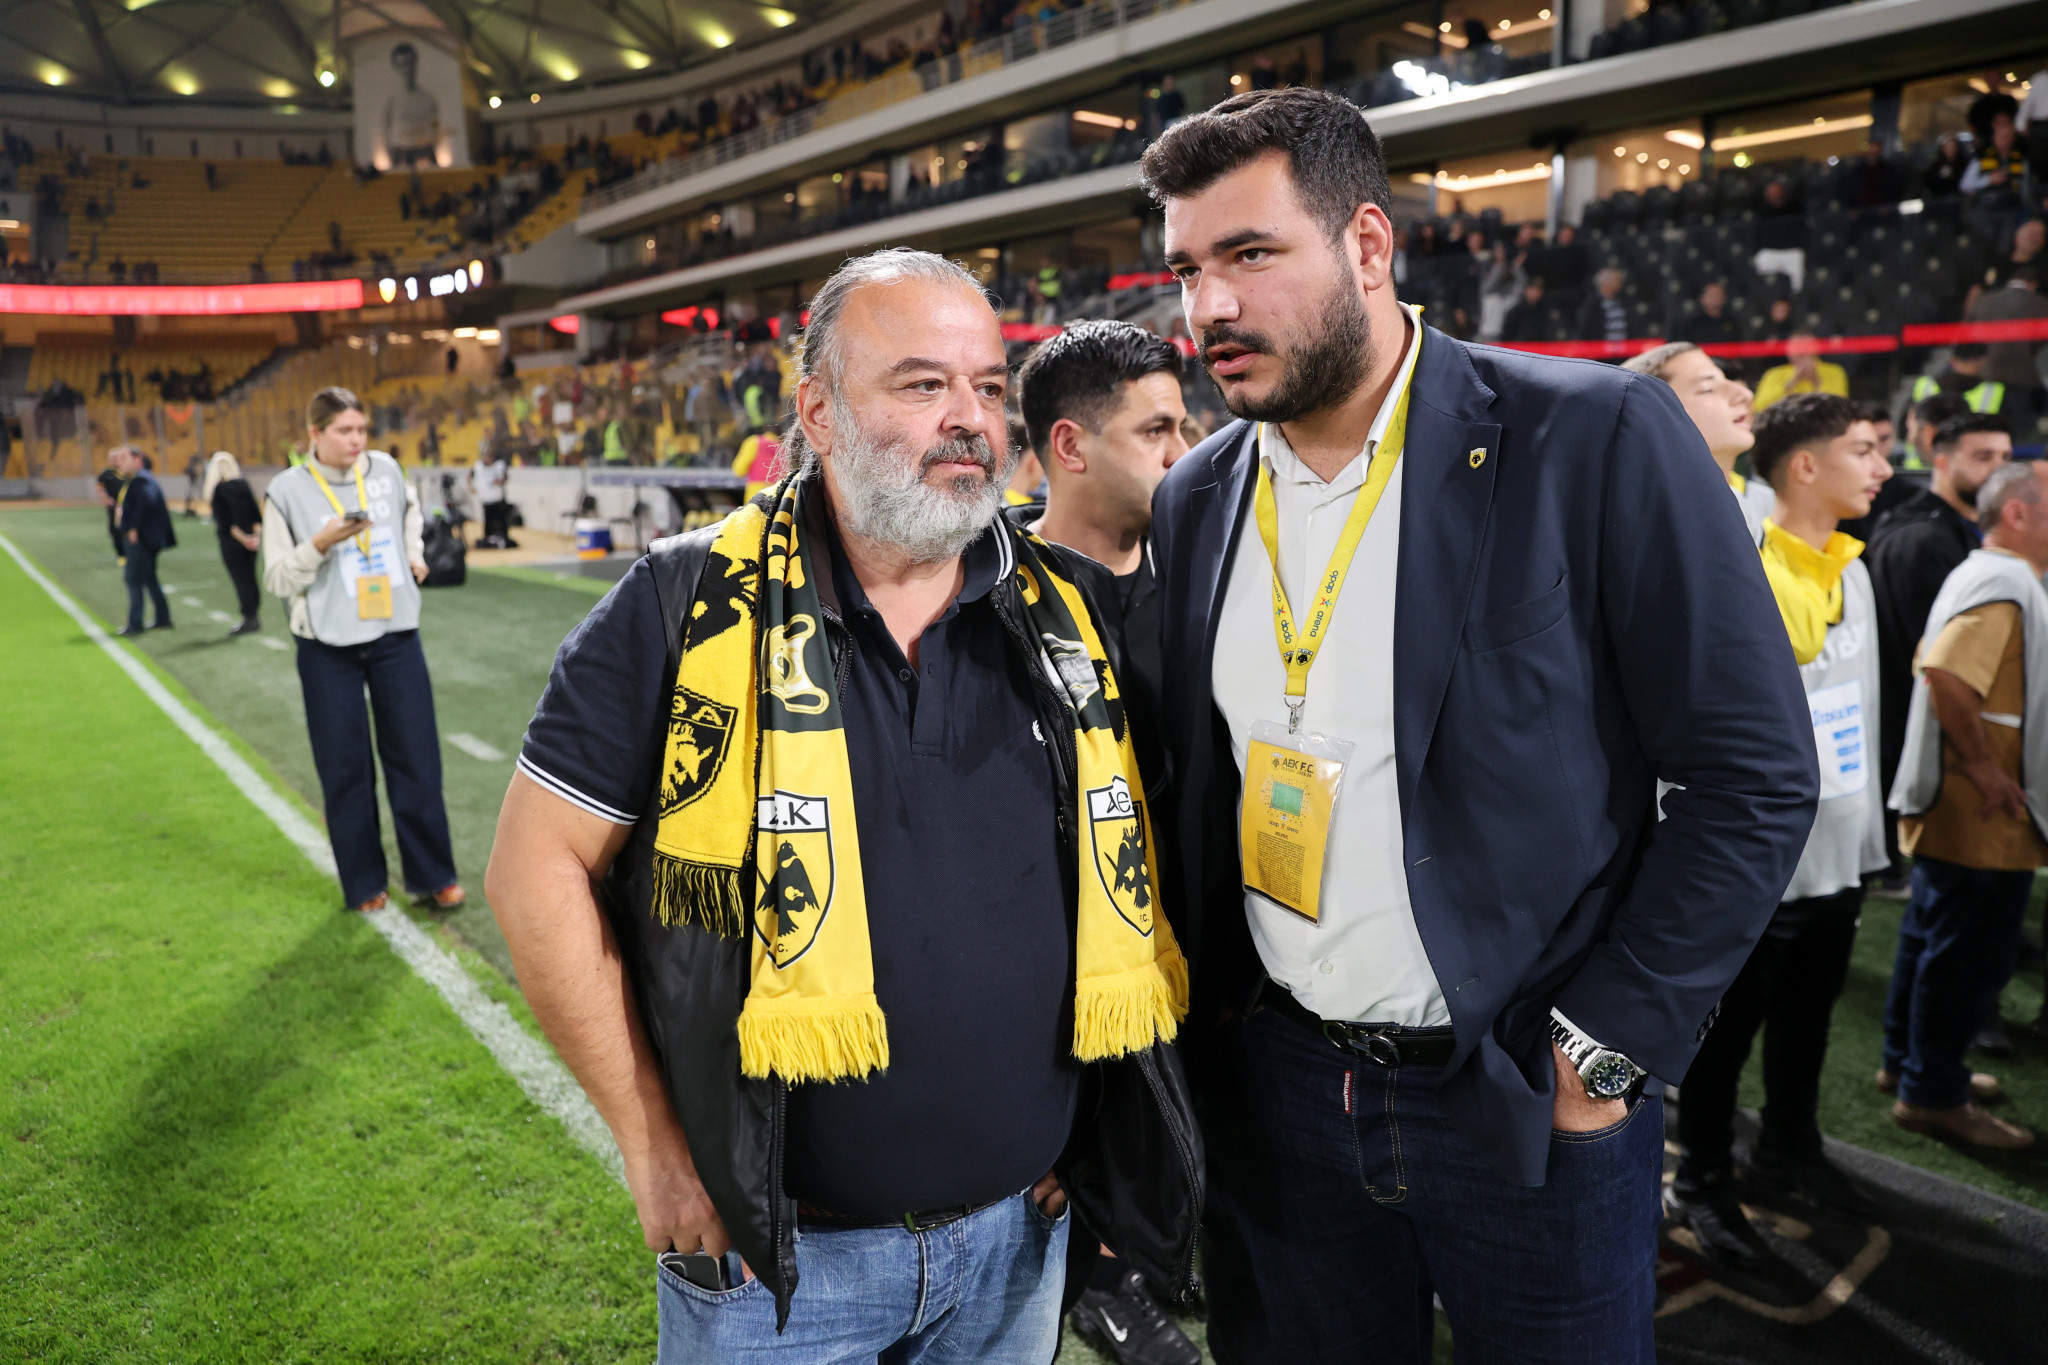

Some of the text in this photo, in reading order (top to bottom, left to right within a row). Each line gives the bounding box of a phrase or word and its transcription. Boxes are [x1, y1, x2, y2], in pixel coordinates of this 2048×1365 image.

[1309, 570, 1339, 637] opap arena
[1280, 619, 1292, 644] opap
[1282, 758, 1314, 774] AEK F.C.
